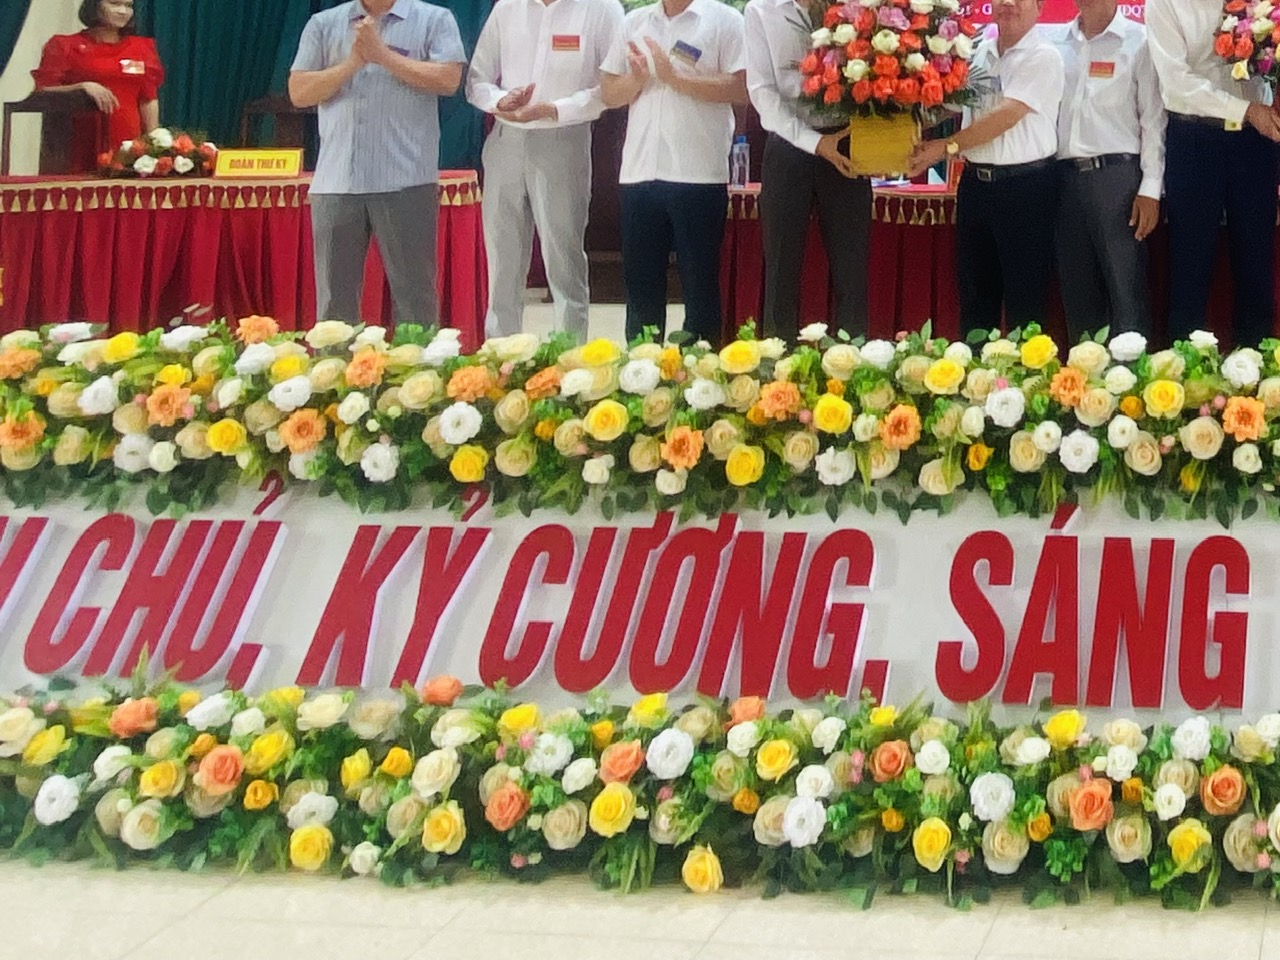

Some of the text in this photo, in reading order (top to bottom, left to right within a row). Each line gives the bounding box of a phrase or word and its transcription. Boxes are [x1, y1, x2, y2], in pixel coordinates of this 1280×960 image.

[24, 470, 284, 691] CHỦ,
[479, 510, 888, 704] CƯƠNG,
[935, 504, 1252, 711] SÁNG
